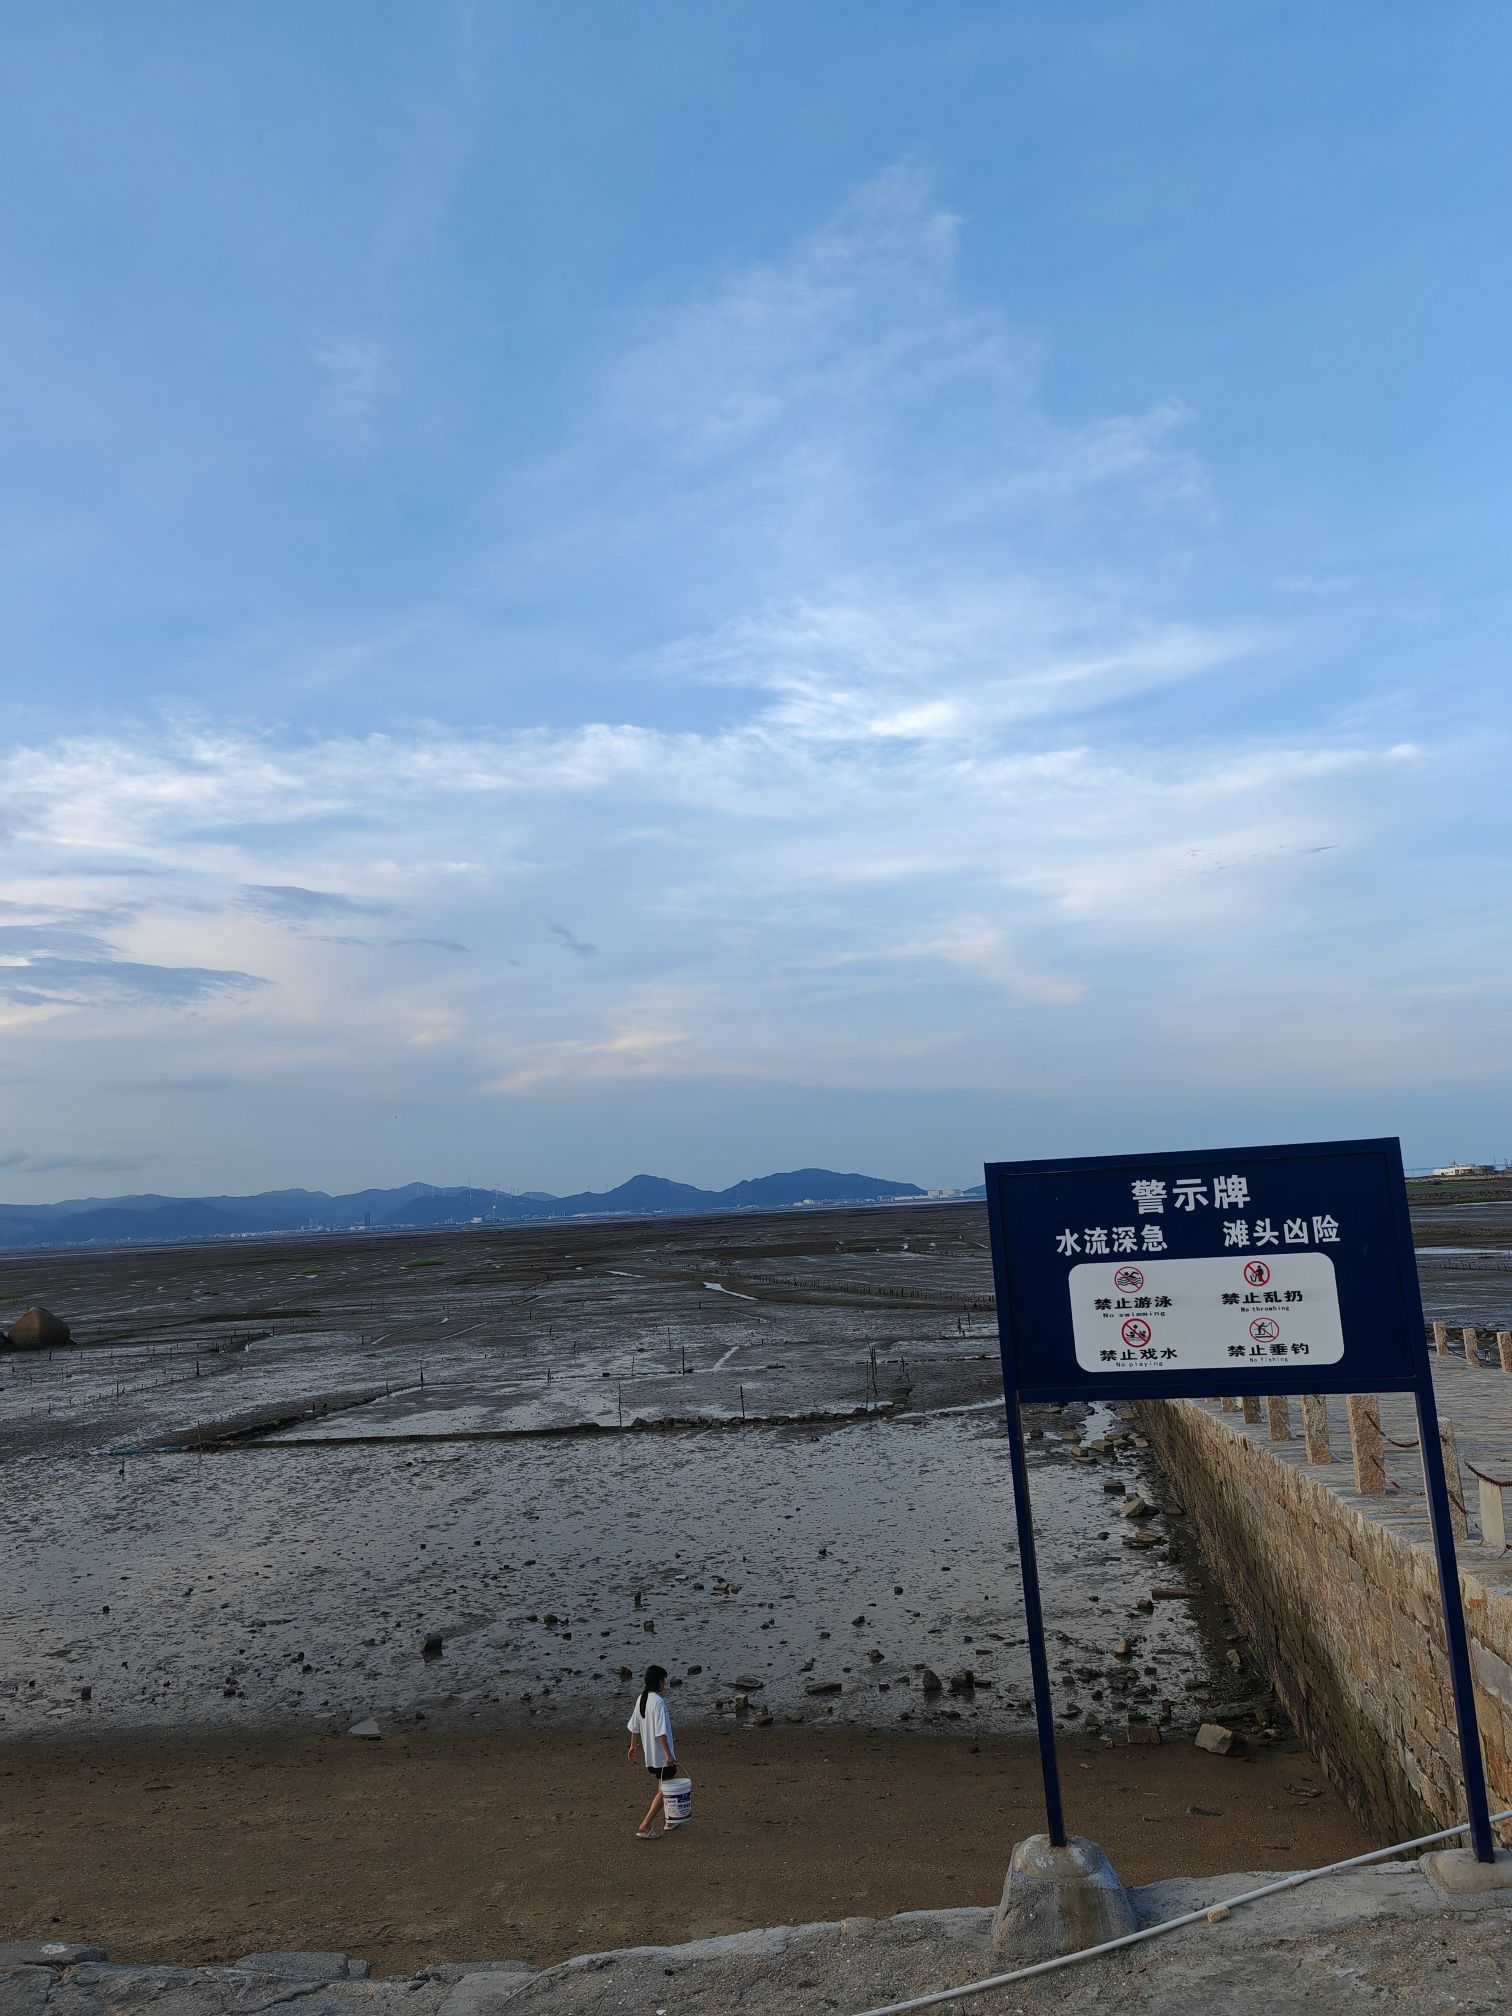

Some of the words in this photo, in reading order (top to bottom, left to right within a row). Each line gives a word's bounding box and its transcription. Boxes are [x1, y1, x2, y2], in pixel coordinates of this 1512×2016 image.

[1131, 1174, 1251, 1215] 警示牌
[1222, 1214, 1341, 1248] 滩头凶险
[1055, 1223, 1168, 1256] 水流深急
[1094, 1295, 1173, 1311] 禁止游泳
[1221, 1290, 1303, 1305] 禁止乱扔
[1119, 1310, 1166, 1318] swimming
[1099, 1347, 1178, 1362] 禁止戏水
[1227, 1342, 1309, 1357] 禁止垂钓
[1128, 1360, 1163, 1368] playing
